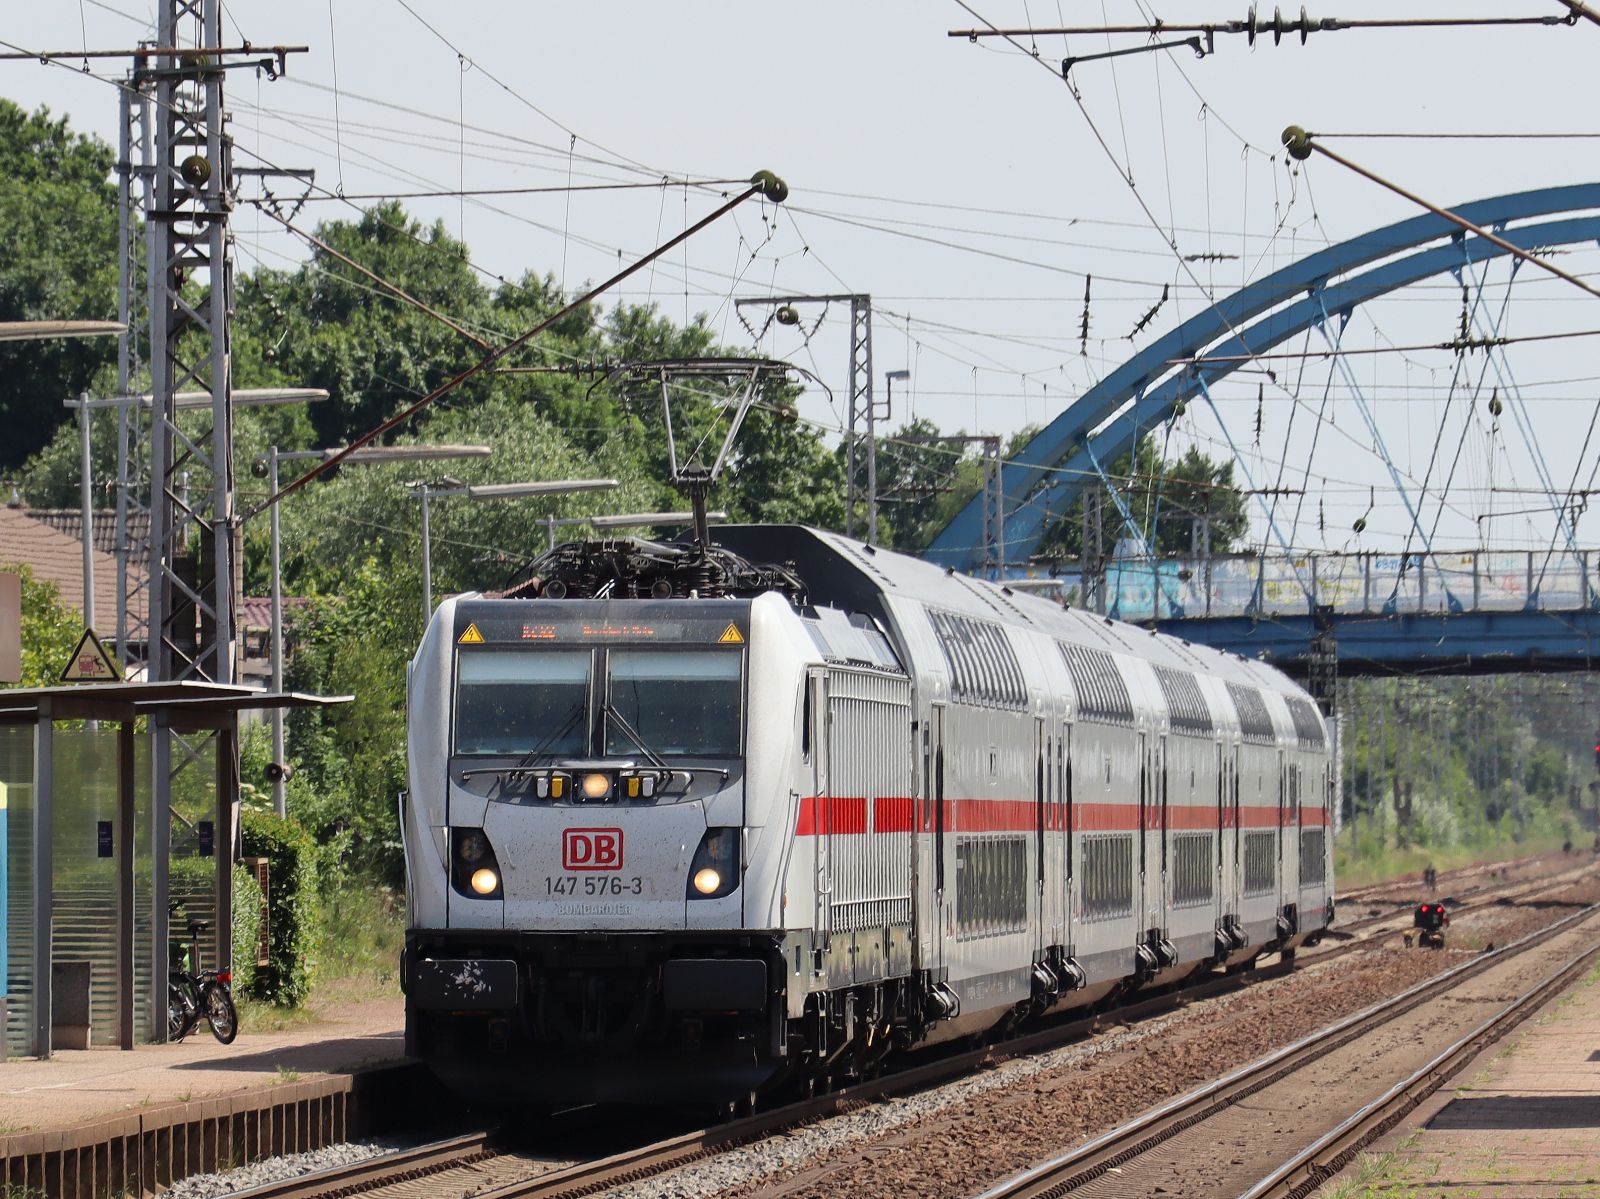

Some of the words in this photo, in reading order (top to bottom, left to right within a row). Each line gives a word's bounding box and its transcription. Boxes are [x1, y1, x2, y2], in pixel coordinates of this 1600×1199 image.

[570, 835, 617, 864] DB
[545, 876, 578, 895] 147
[585, 876, 642, 895] 576-3
